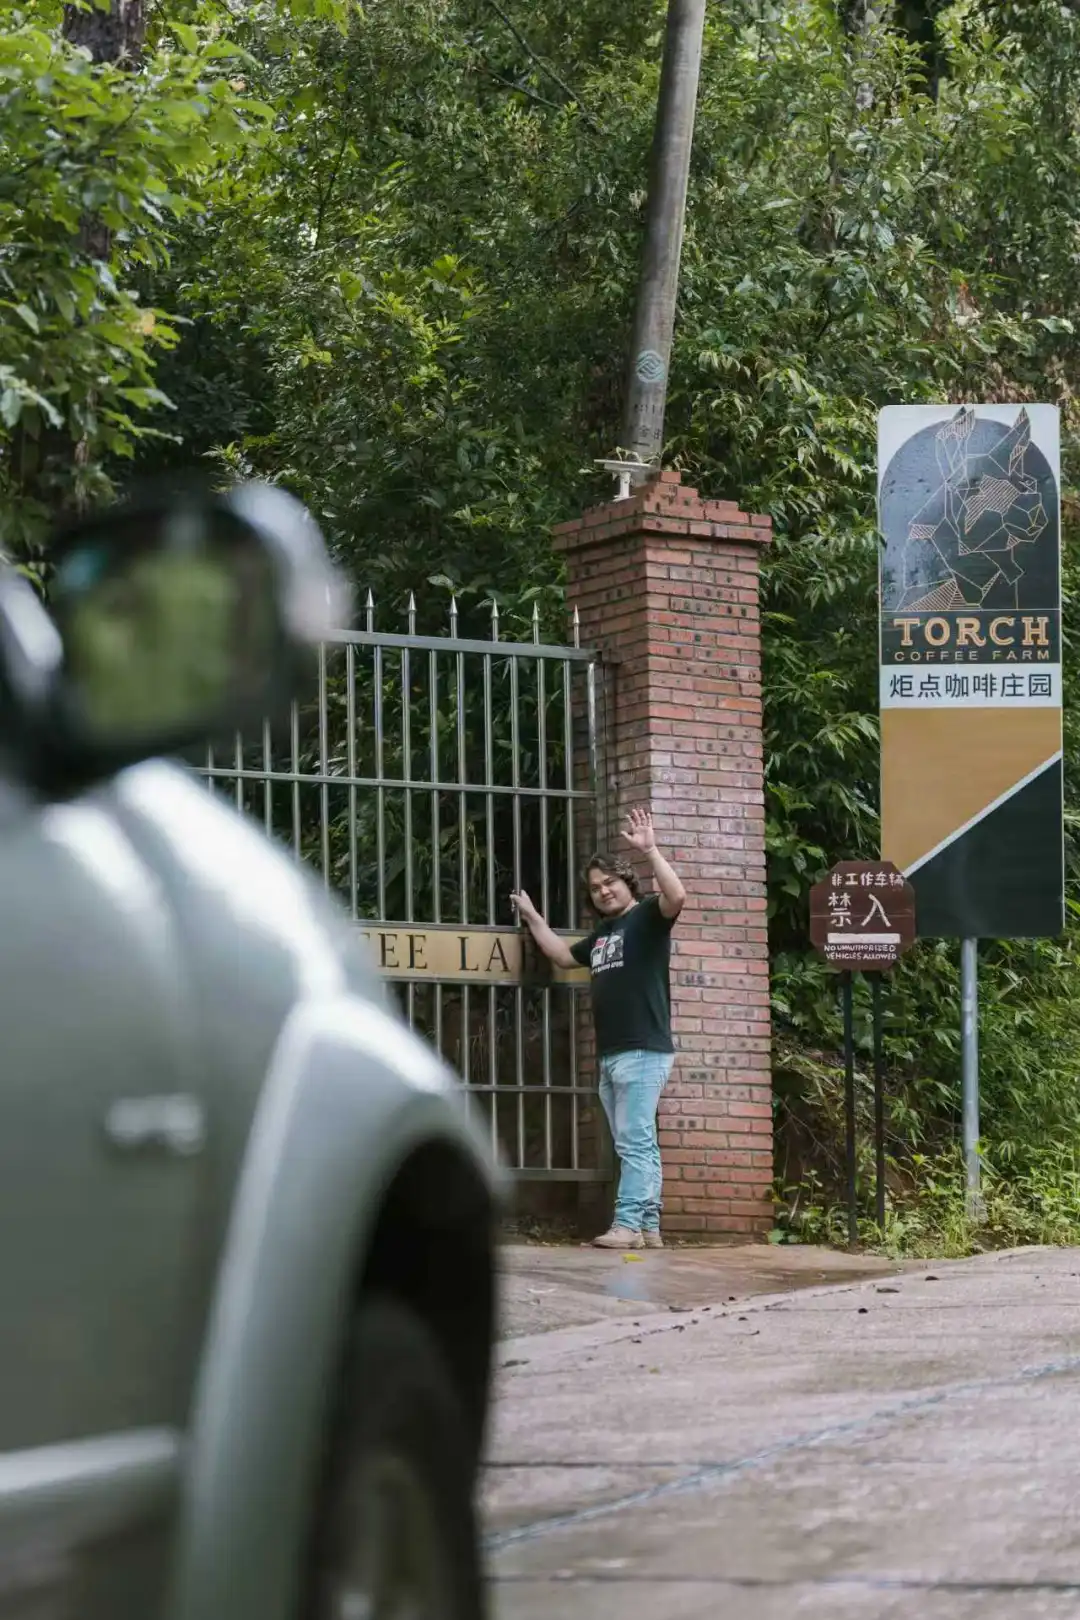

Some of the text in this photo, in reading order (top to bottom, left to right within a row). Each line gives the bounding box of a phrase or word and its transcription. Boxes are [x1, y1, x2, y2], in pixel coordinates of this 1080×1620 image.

[893, 616, 1049, 647] TORCH
[894, 650, 1050, 661] COFFEE FARM
[889, 673, 1052, 698] 炬点咖啡庄园
[828, 892, 892, 927] 禁入
[358, 932, 428, 969] EE
[824, 944, 836, 952] NO
[826, 952, 897, 960] VEHICLES ALLOWED
